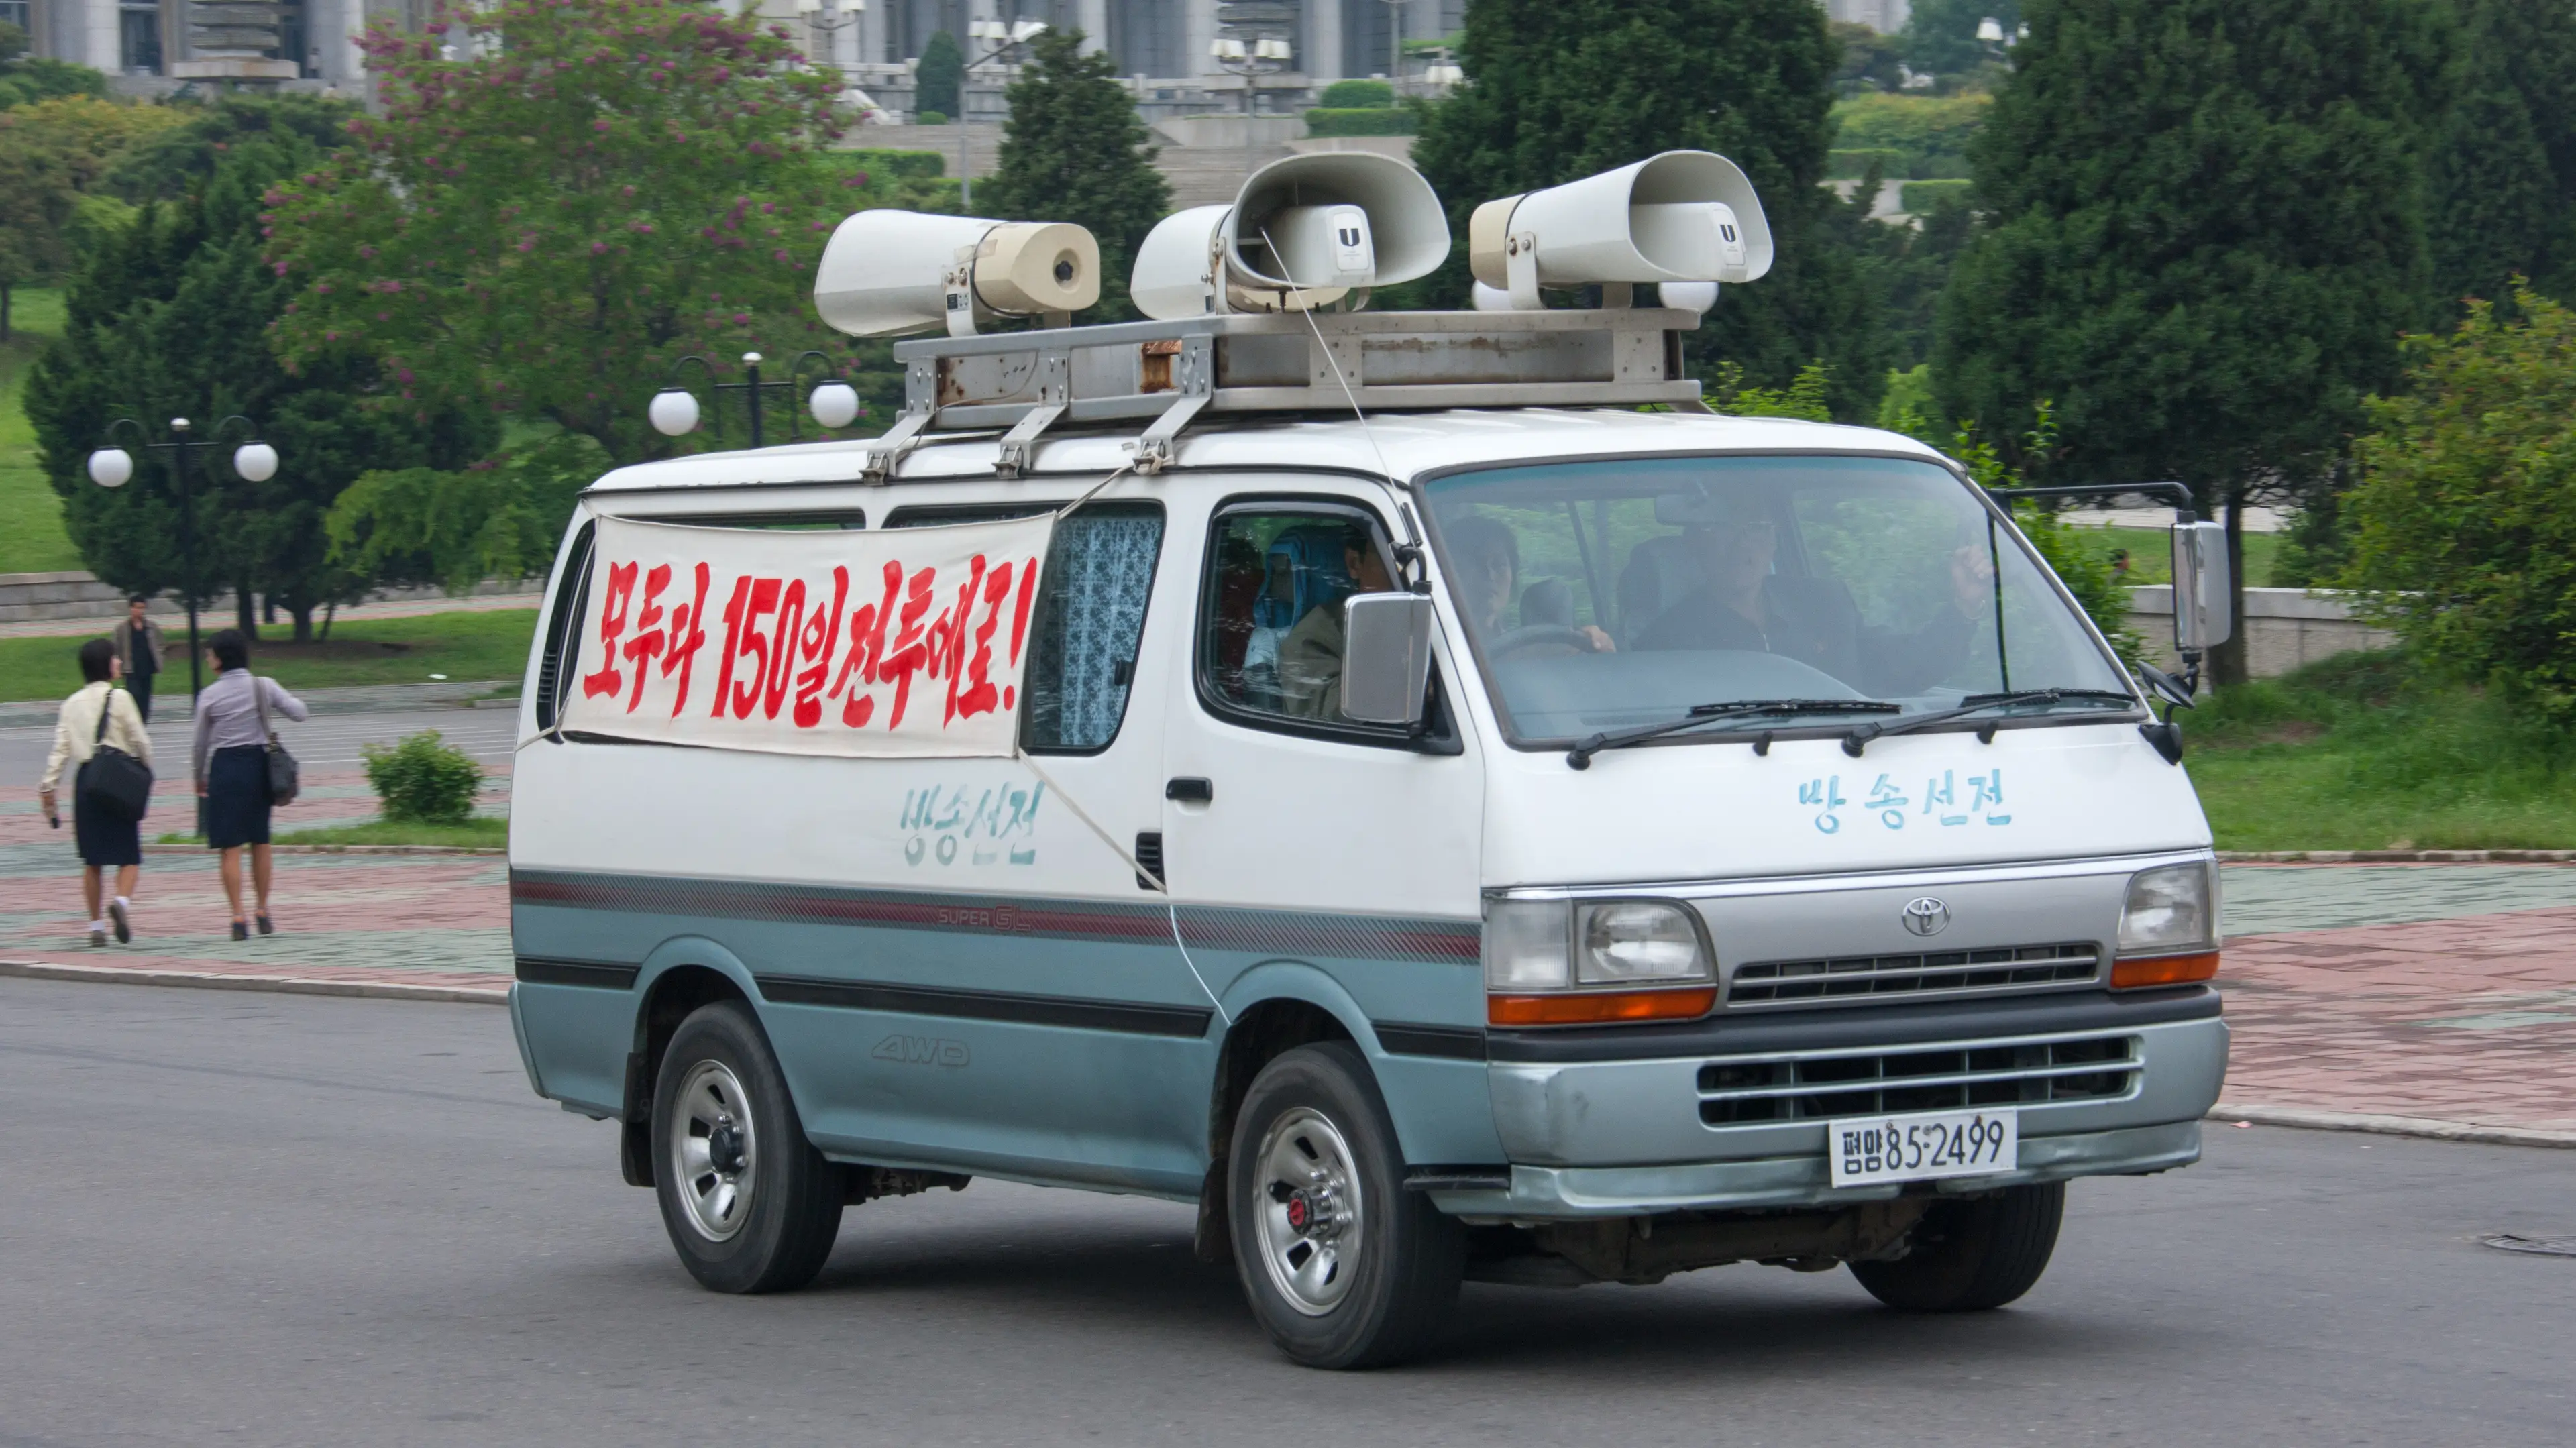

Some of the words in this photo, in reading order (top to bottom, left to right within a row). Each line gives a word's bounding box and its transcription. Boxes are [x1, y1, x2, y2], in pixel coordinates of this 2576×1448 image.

[938, 909, 989, 926] SUPER
[993, 905, 1030, 932] GL
[871, 1034, 971, 1067] 4WD
